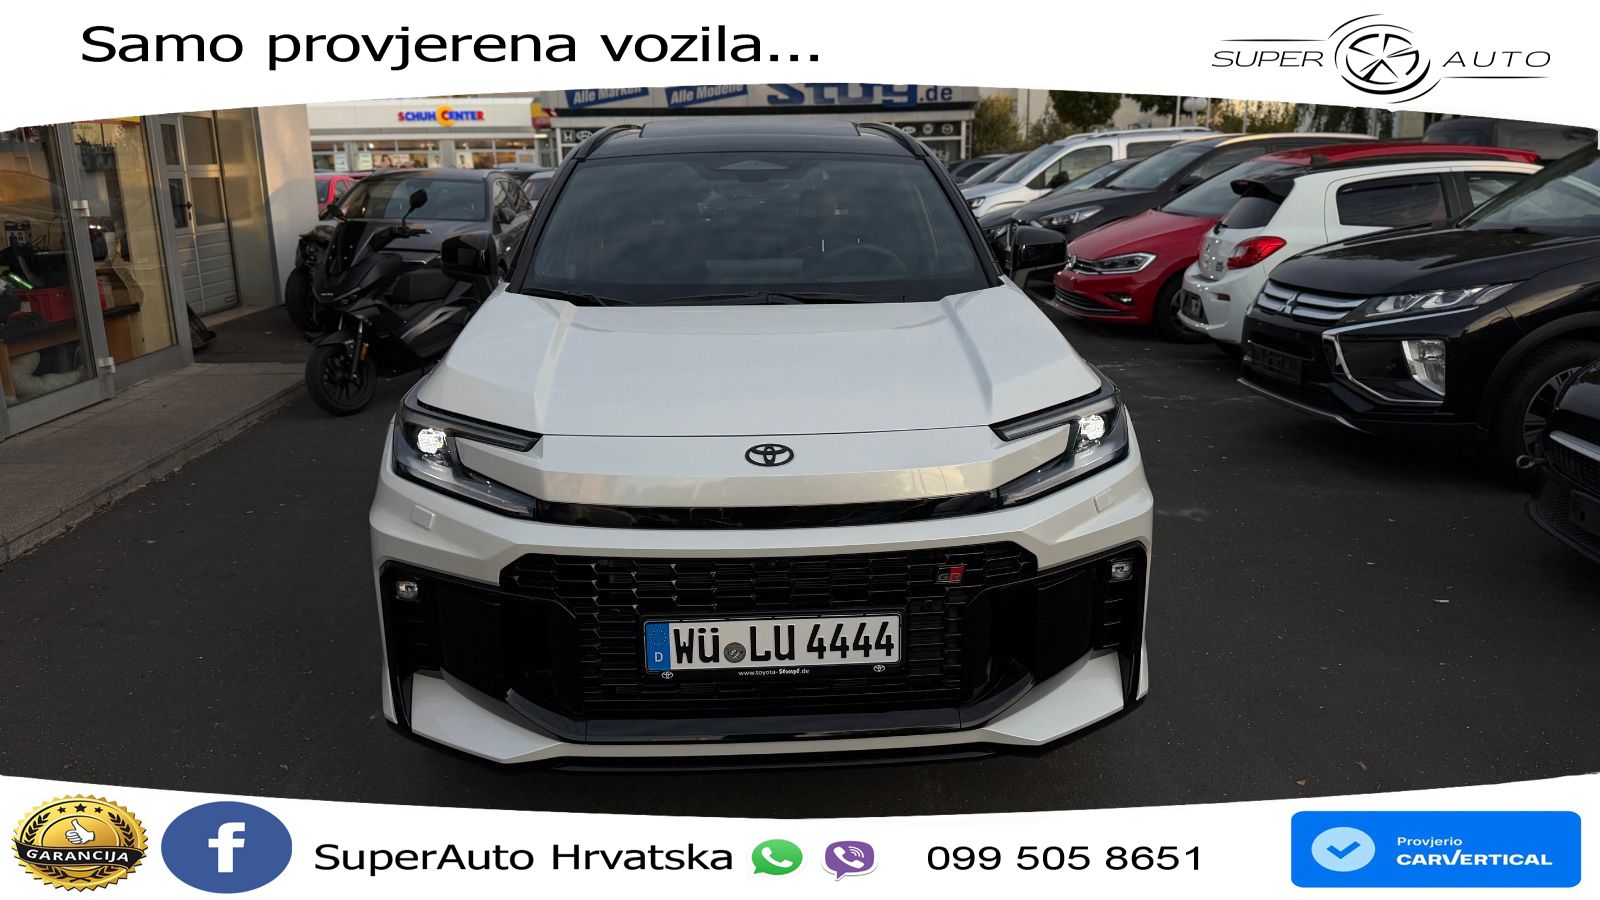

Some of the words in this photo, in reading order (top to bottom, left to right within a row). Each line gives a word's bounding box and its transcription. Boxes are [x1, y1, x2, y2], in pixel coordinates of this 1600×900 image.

[573, 88, 596, 105] Alle
[670, 87, 694, 105] Alle
[696, 84, 744, 100] Modelle
[398, 110, 437, 122] SCHUH
[440, 109, 485, 121] CENTER
[654, 651, 664, 663] D
[750, 624, 796, 662] LU
[806, 621, 895, 660] 4444
